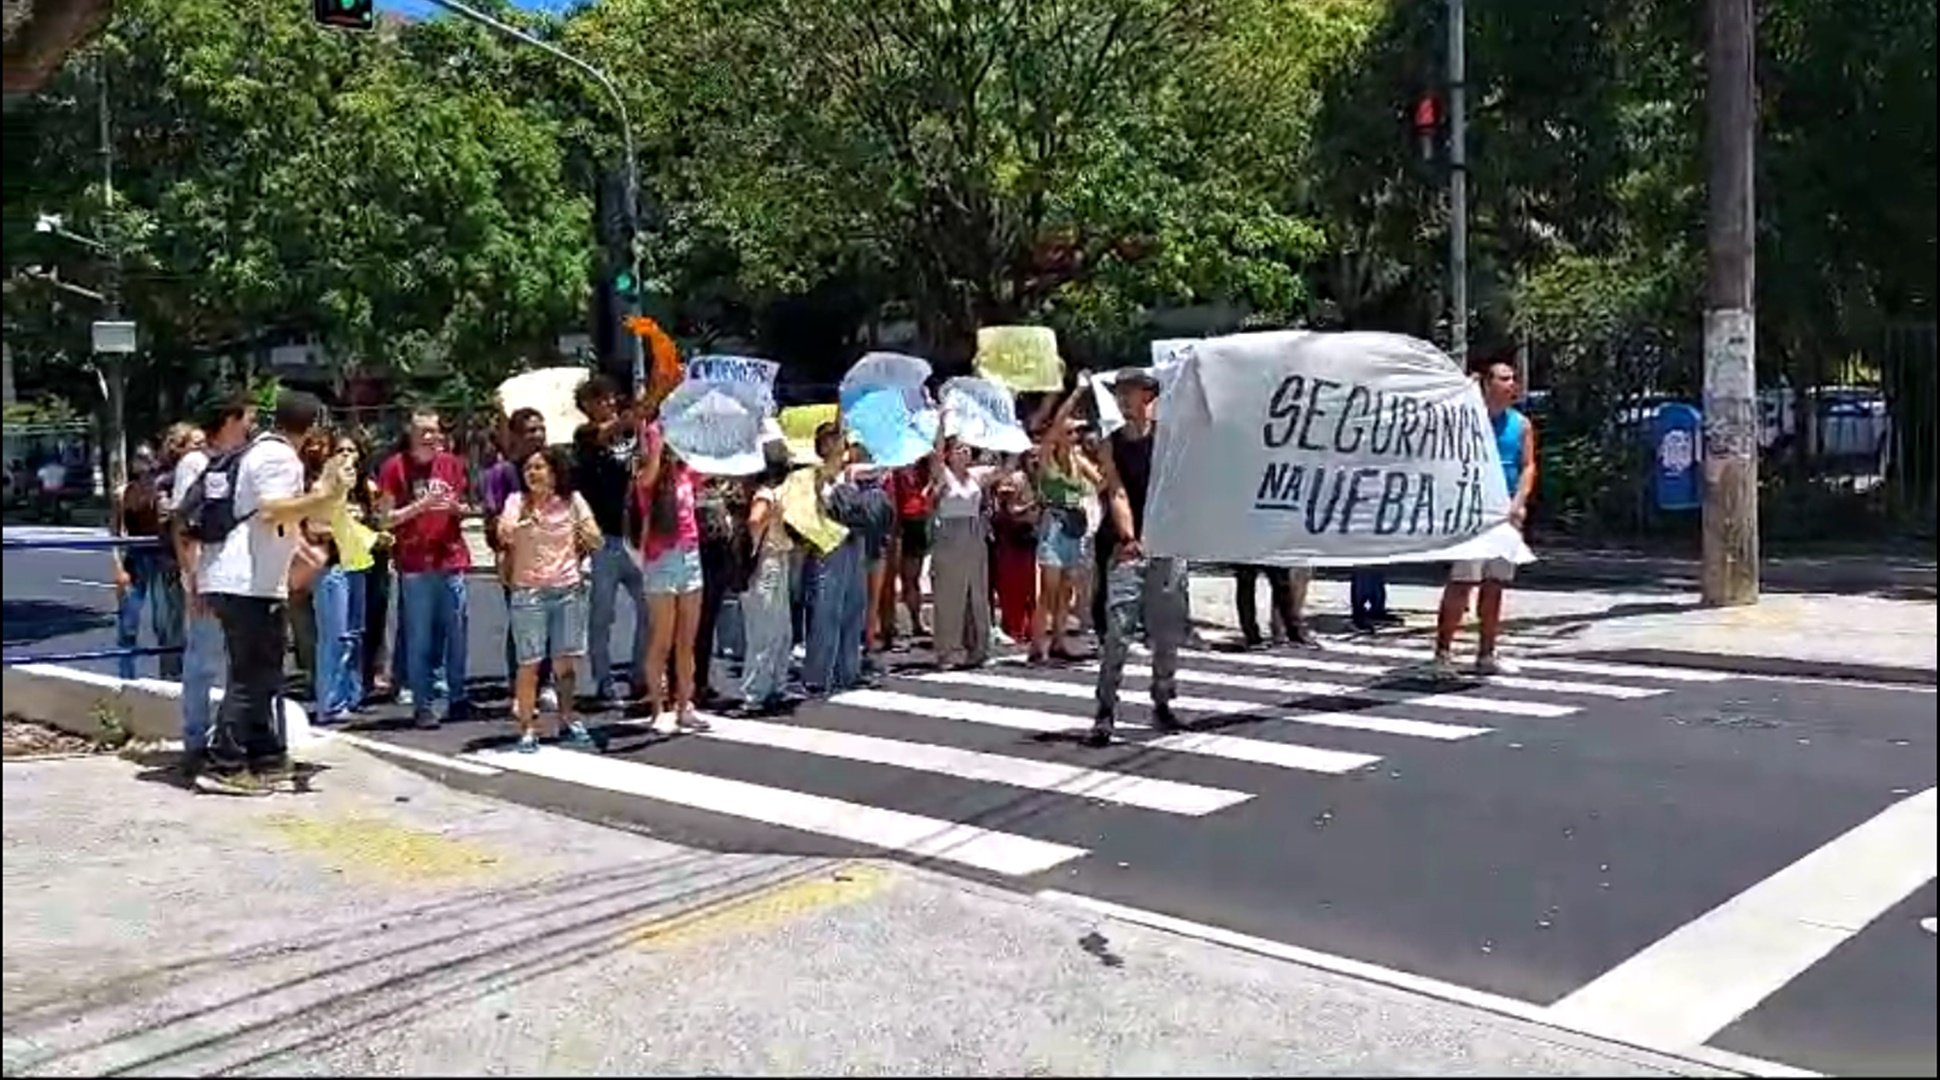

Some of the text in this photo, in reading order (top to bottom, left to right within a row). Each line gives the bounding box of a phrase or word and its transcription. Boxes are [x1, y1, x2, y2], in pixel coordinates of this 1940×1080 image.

[1262, 374, 1489, 477] SEGURANÇA
[1257, 462, 1484, 536] NA UFBA JÁ
